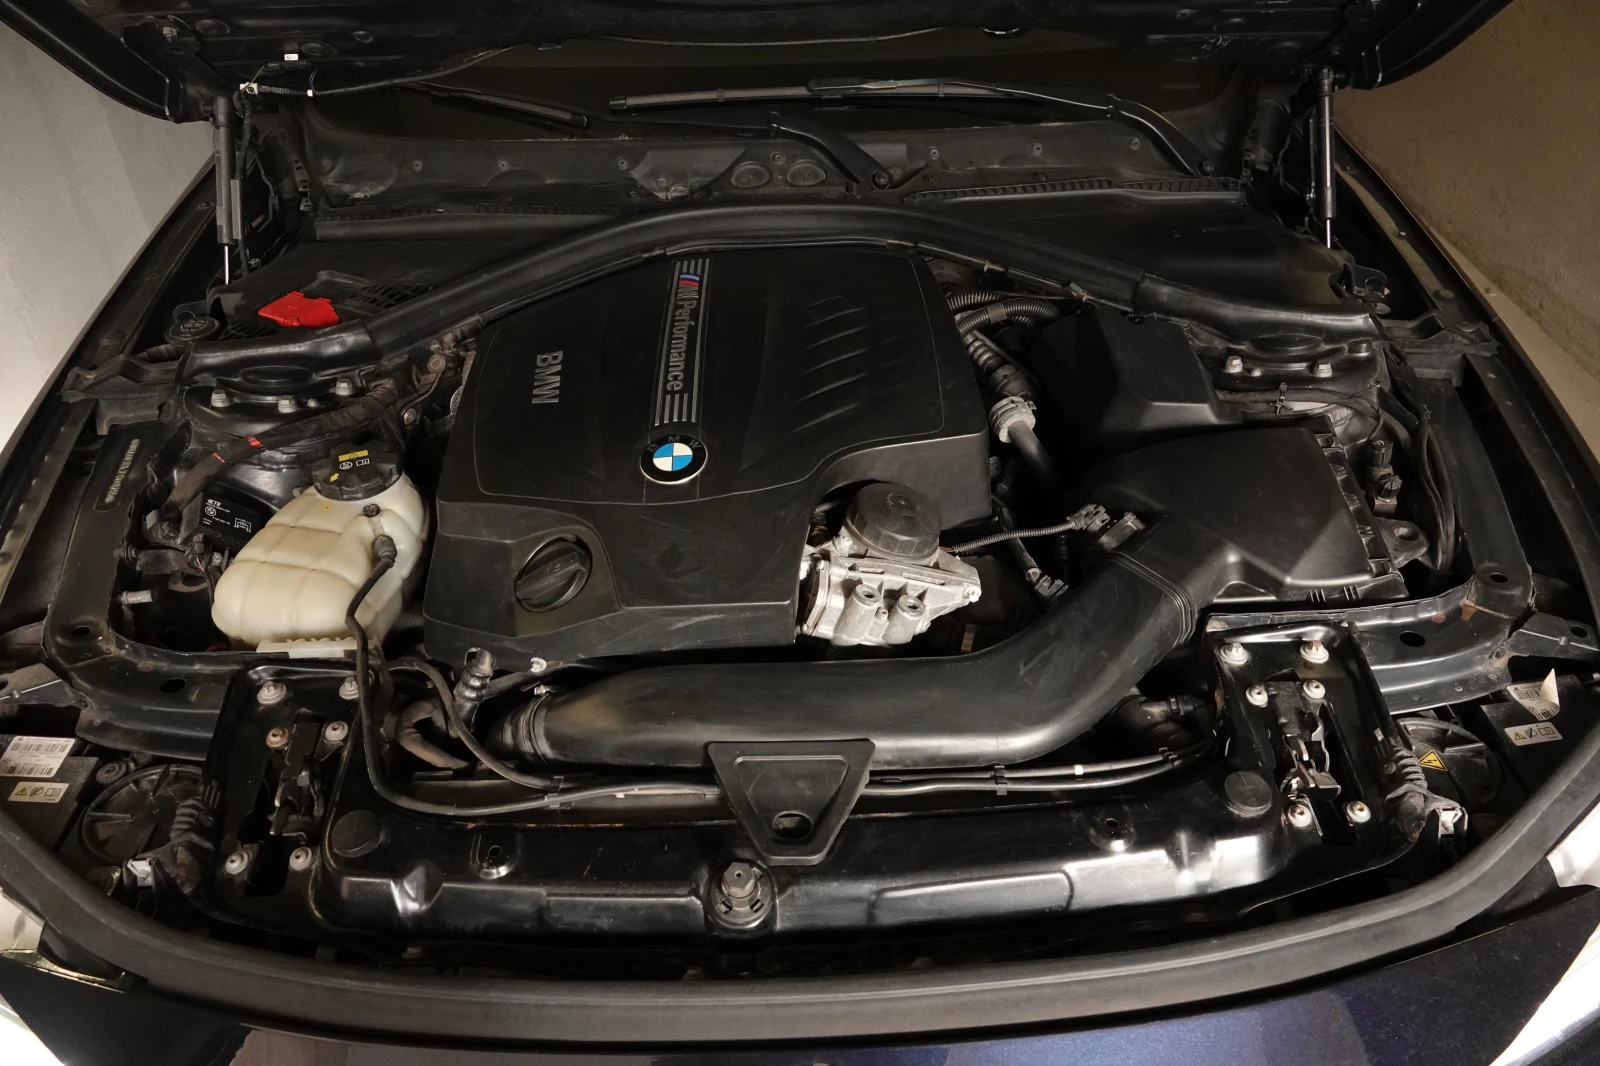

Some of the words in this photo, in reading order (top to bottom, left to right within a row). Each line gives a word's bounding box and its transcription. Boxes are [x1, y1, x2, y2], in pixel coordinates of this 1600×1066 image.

[666, 300, 698, 391] Performance
[531, 350, 564, 404] BMW
[646, 435, 703, 453] BMW
